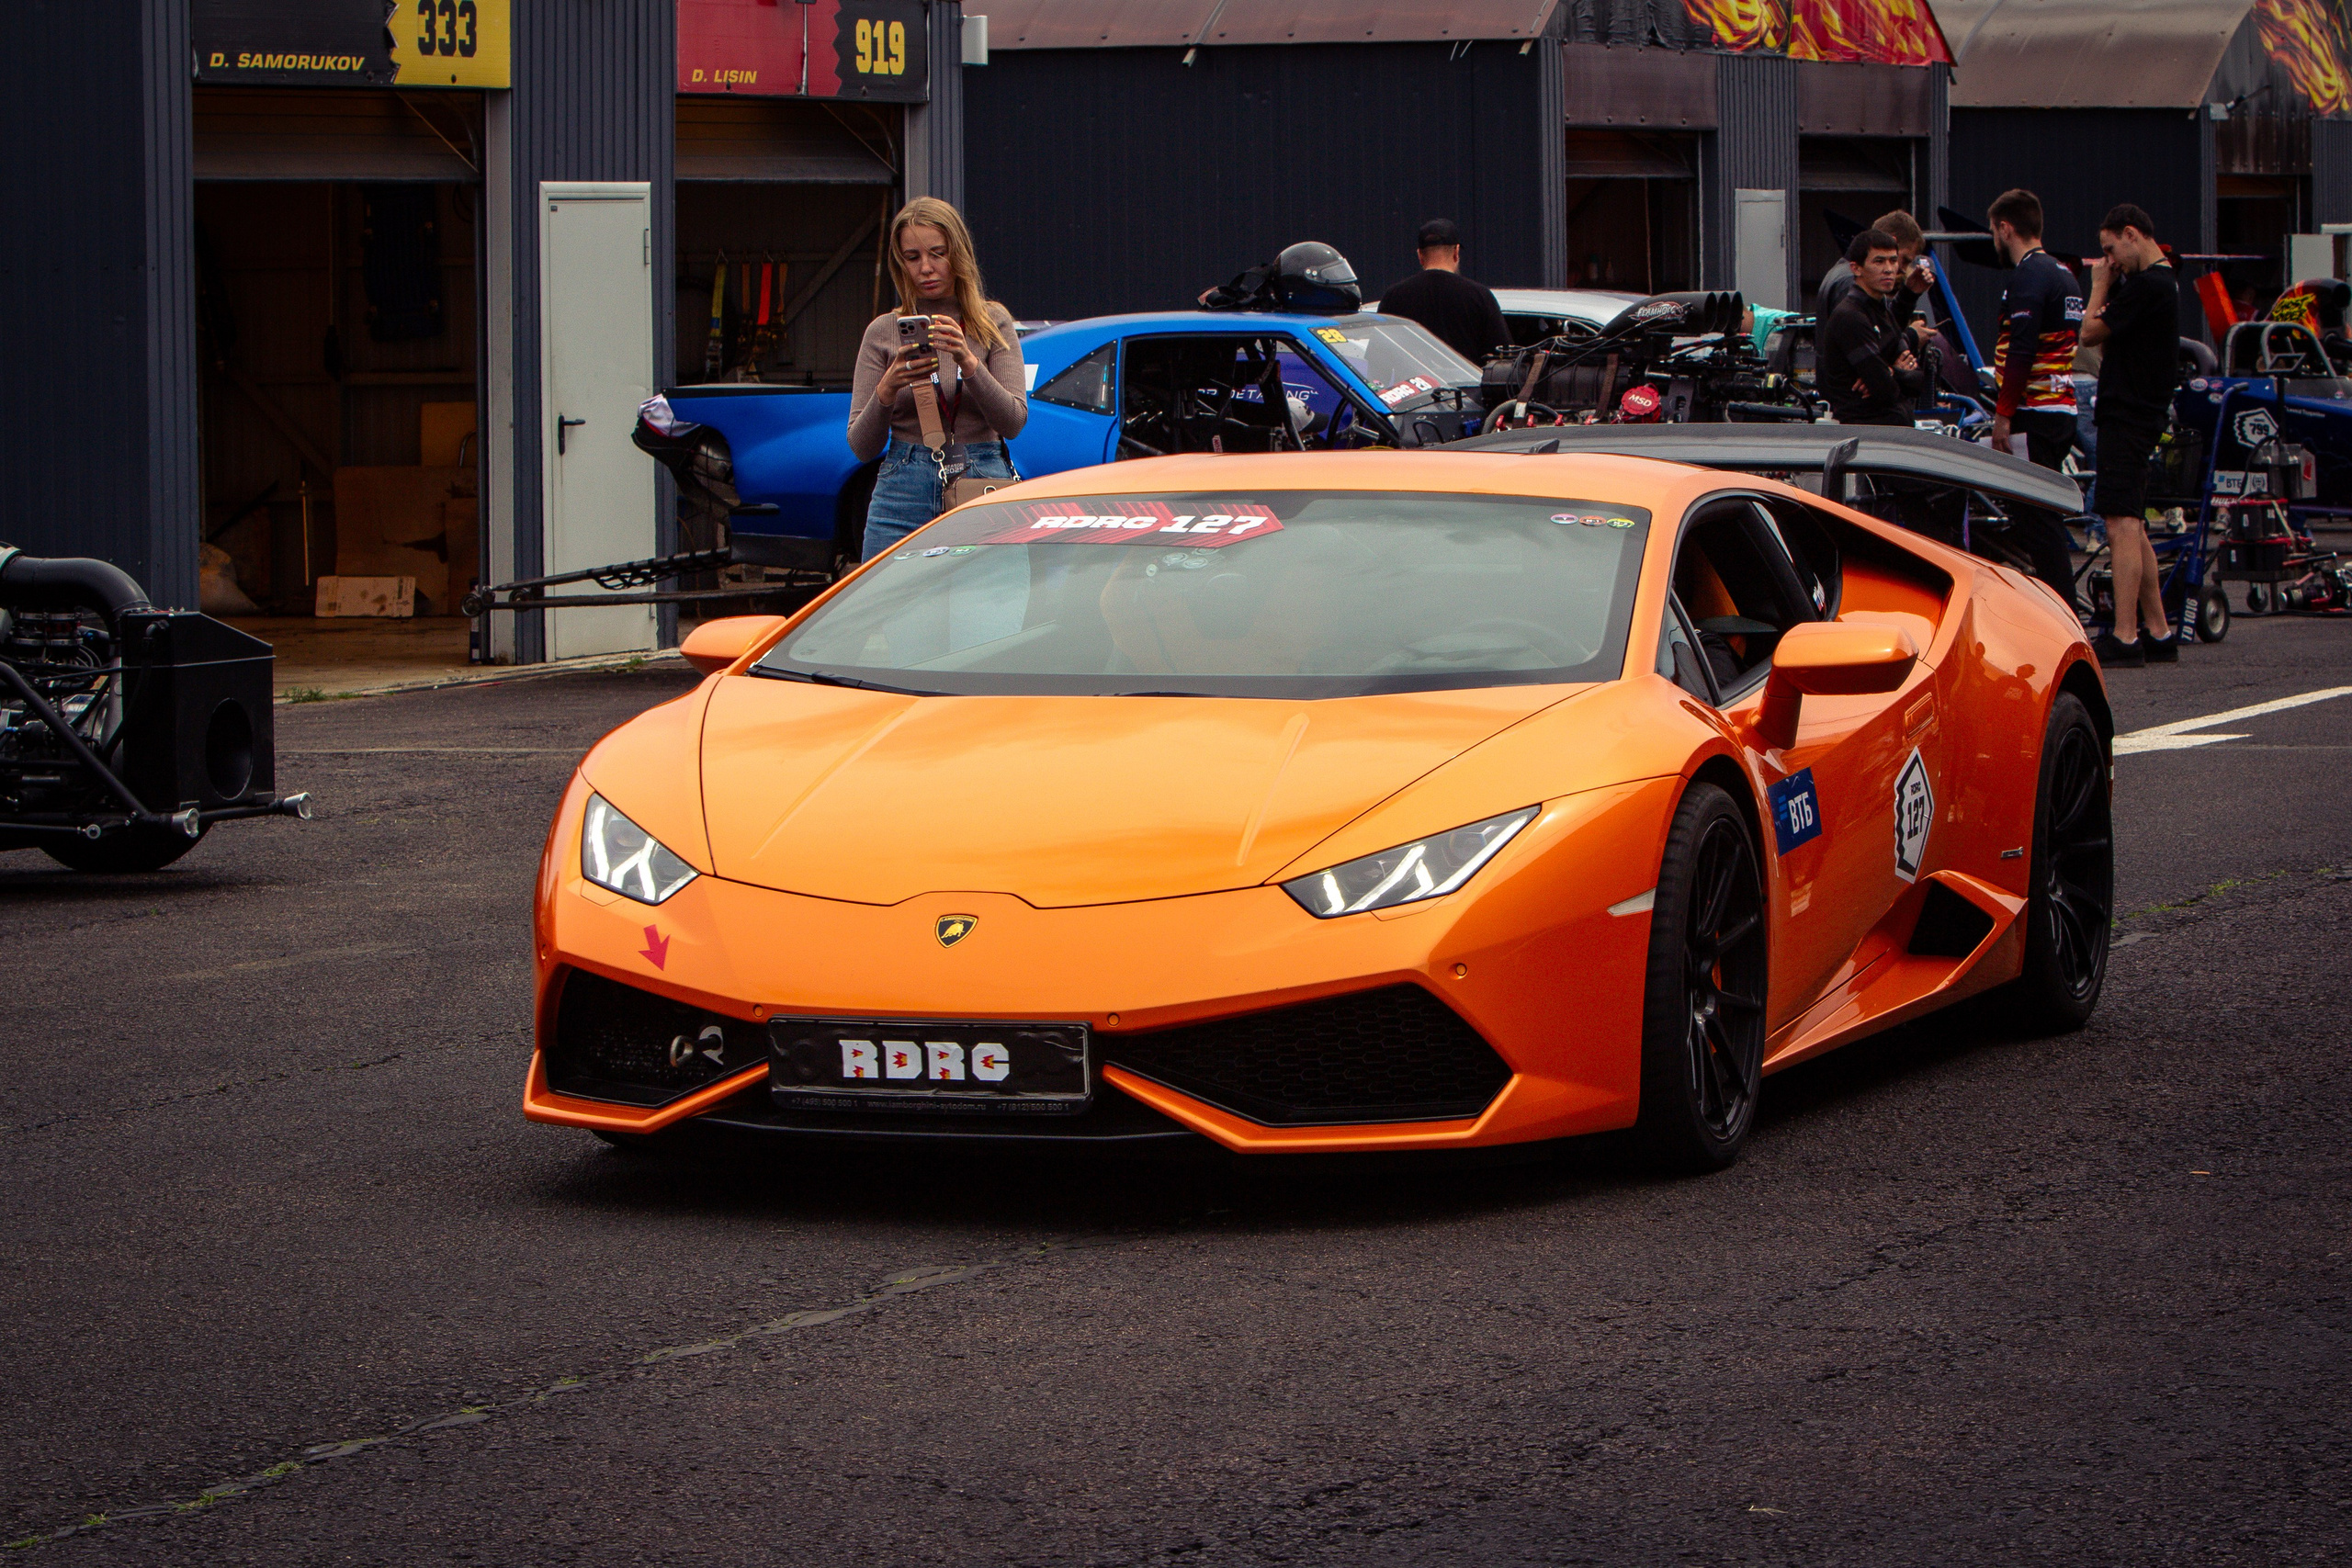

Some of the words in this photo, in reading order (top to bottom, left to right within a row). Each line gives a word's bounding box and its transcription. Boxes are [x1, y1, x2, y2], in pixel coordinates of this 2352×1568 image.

[418, 0, 477, 58] 333
[855, 18, 905, 75] 919
[209, 52, 229, 68] D.
[237, 52, 365, 71] SAMORUKOV
[692, 69, 707, 83] D.
[714, 70, 757, 84] LISIN
[1317, 329, 1349, 344] 28
[1379, 384, 1415, 404] RDRC
[1629, 394, 1652, 407] MSD
[2249, 423, 2269, 435] 799
[1030, 515, 1158, 529] RDRC
[1159, 514, 1268, 535] 127
[2184, 598, 2198, 624] 1016
[1788, 792, 1813, 834] ВТБ
[1907, 795, 1924, 840] 127
[839, 1040, 1010, 1081] RDRC
